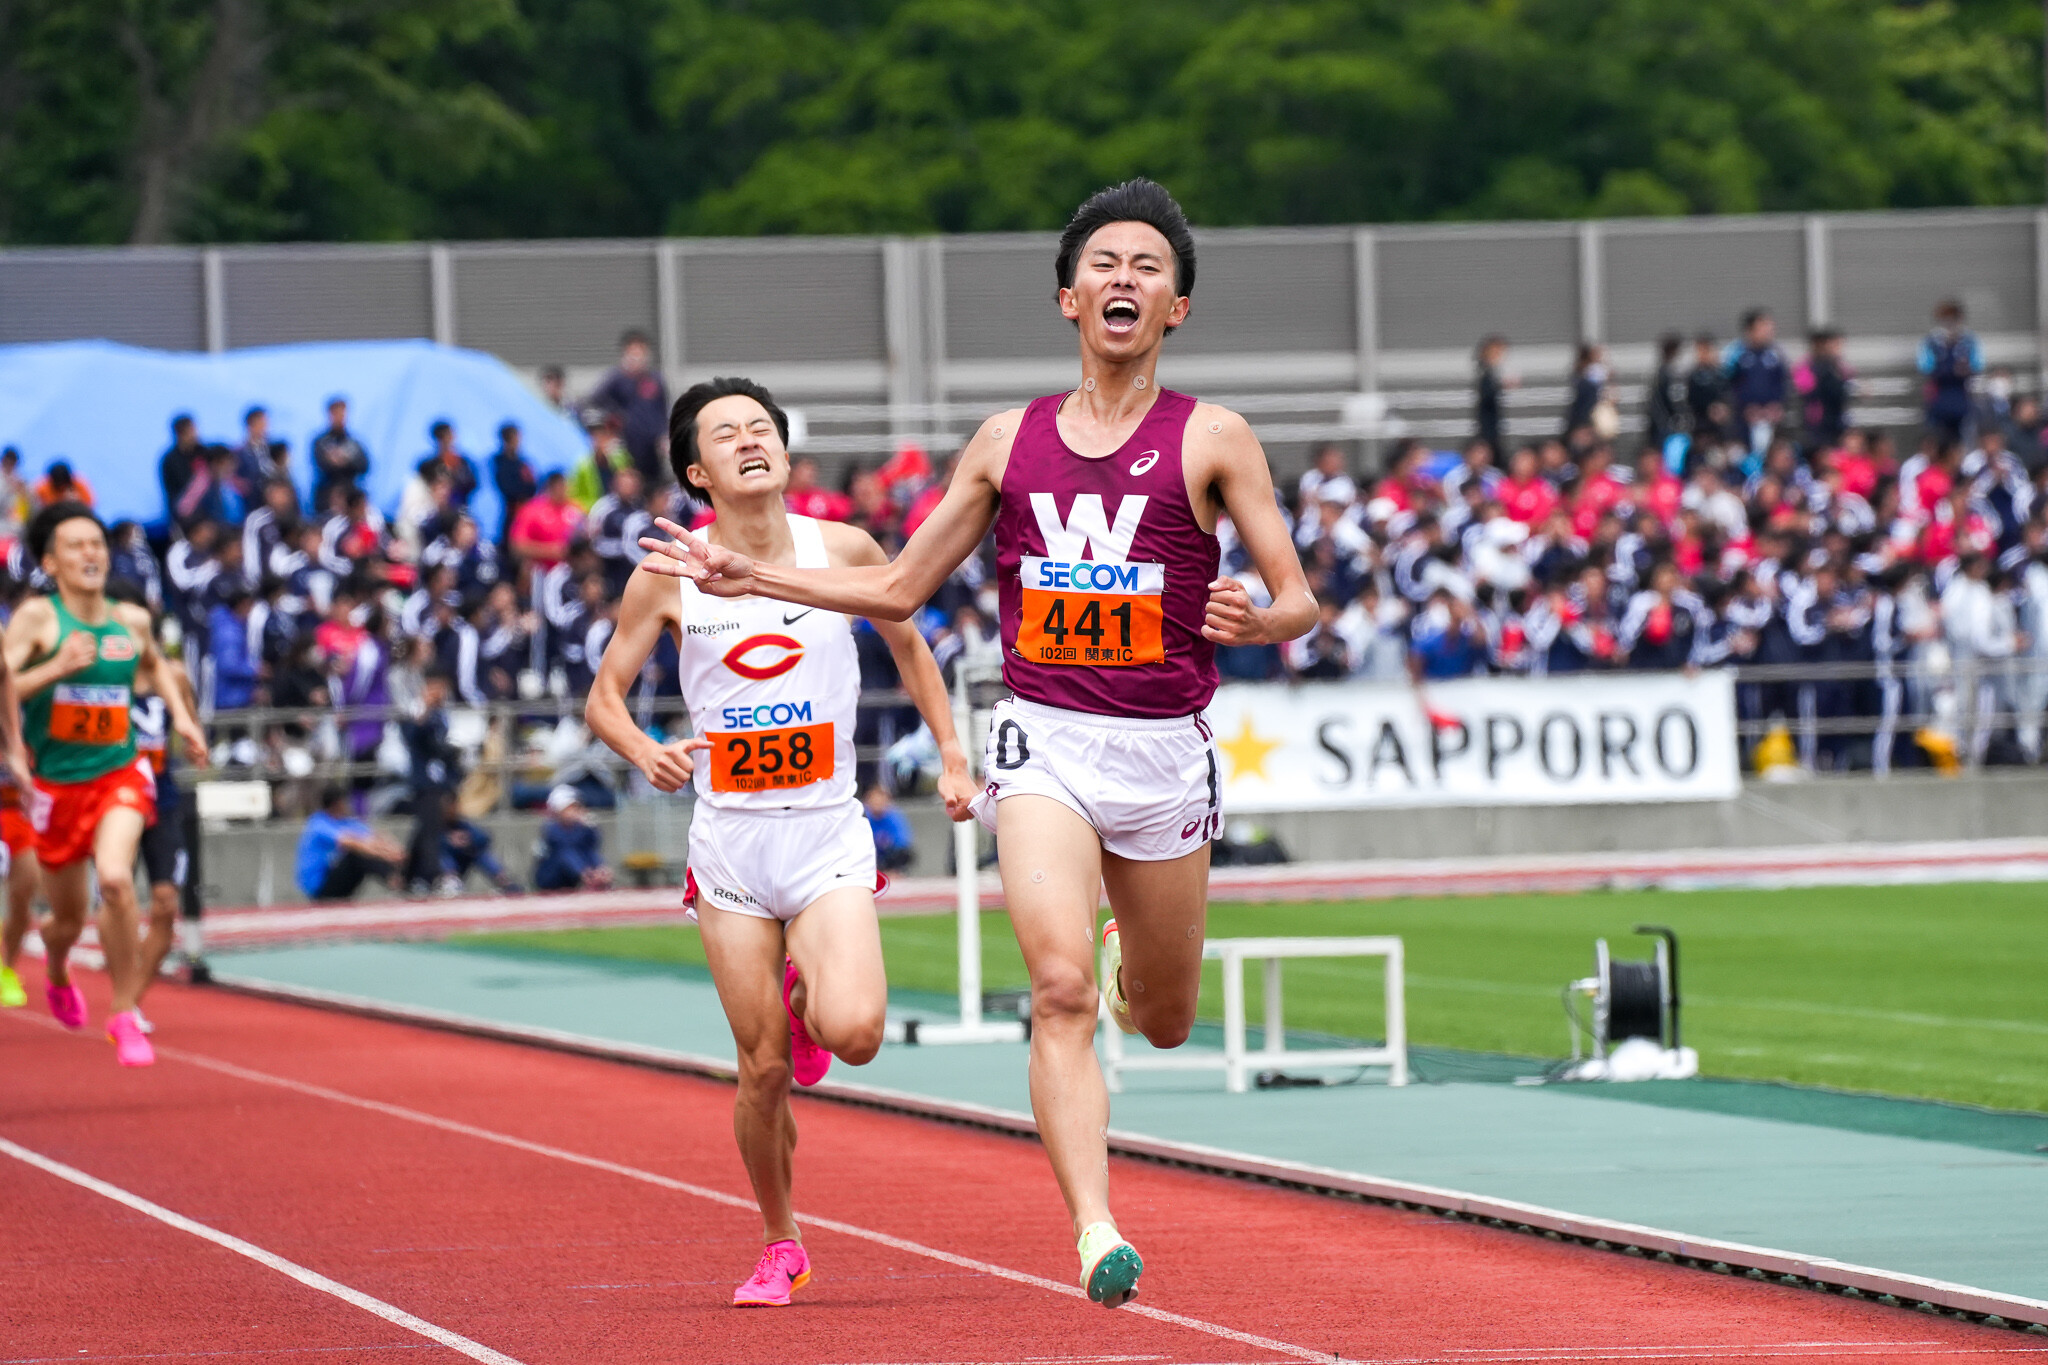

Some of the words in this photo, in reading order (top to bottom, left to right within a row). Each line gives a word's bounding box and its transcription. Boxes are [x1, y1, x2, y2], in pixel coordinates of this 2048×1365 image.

[1028, 492, 1150, 563] W
[1039, 561, 1139, 592] SECOM
[687, 619, 740, 636] Regain
[1043, 598, 1132, 647] 441
[1040, 646, 1077, 660] 102回
[1084, 647, 1134, 662] 関東IC
[72, 707, 112, 735] 28
[722, 700, 813, 729] SECOM
[727, 731, 814, 776] 258
[1314, 707, 1700, 789] SAPPORO
[735, 777, 766, 789] 102回
[772, 770, 812, 786] 関東IC
